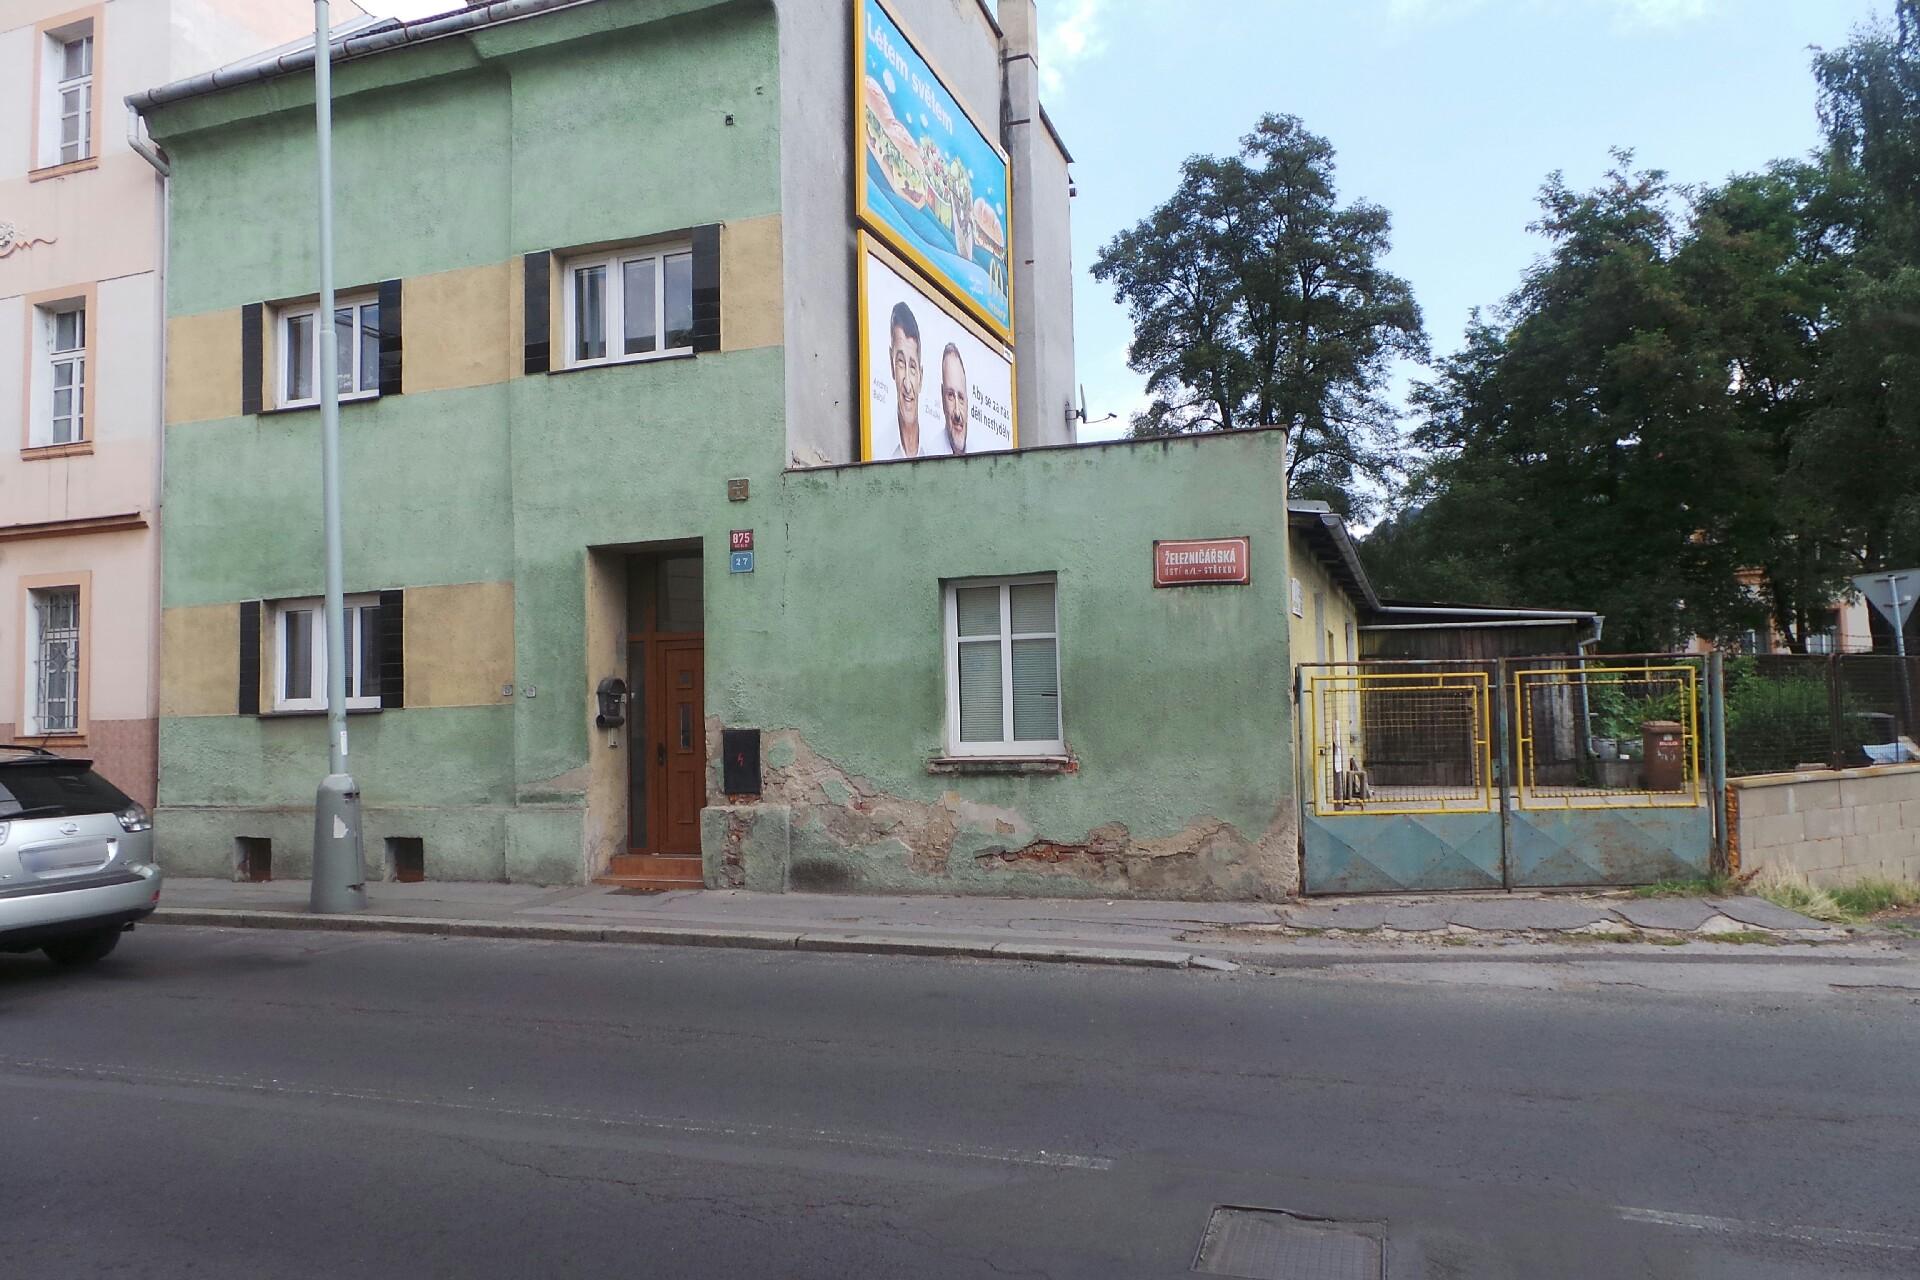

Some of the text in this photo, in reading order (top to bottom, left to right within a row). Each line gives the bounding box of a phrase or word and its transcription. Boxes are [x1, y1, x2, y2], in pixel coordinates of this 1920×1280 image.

[972, 384, 984, 405] Aby
[985, 395, 992, 408] se
[970, 405, 983, 424] děti
[735, 557, 748, 566] 27
[1164, 547, 1236, 566] ŽELEZNIČÁŘSKÁ
